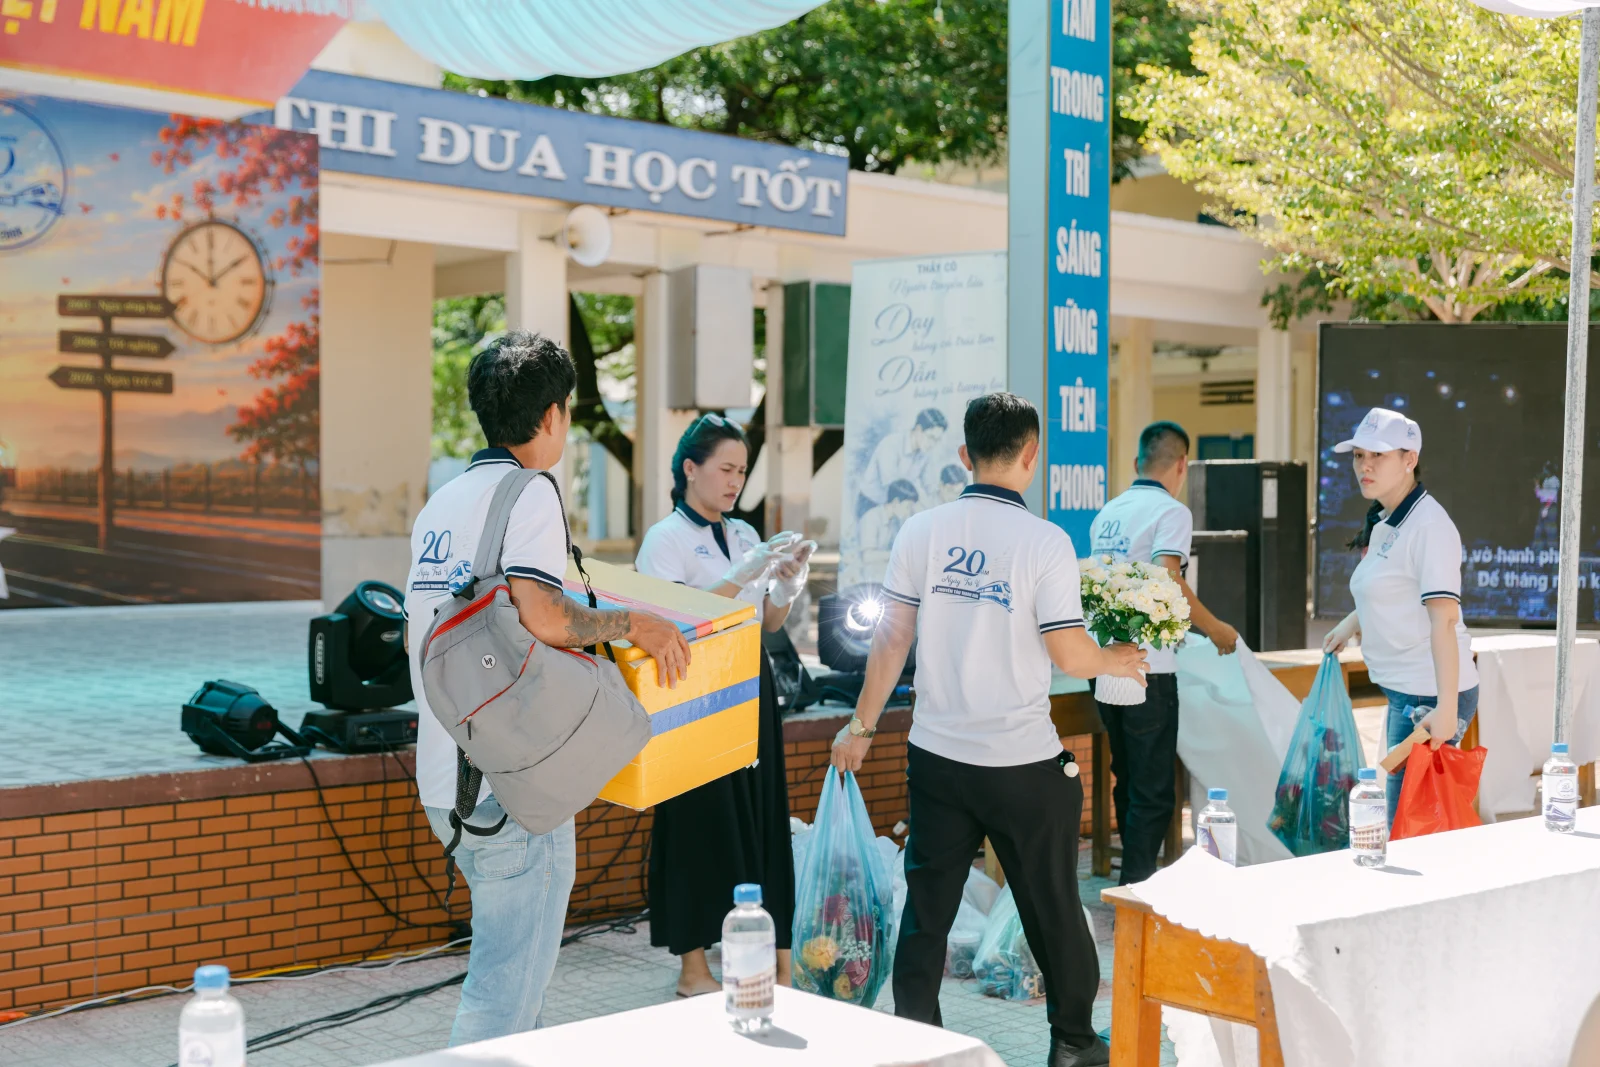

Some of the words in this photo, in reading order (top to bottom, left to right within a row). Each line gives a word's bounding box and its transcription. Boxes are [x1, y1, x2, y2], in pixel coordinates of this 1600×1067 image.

[1051, 65, 1103, 122] TRONG
[417, 117, 567, 181] ĐUA
[584, 142, 717, 204] HỌC
[731, 157, 841, 217] TỐT
[1064, 143, 1090, 198] TRÍ
[1056, 219, 1101, 278] SÁNG
[871, 302, 935, 346] Dạy
[1053, 298, 1098, 355] VỮNG
[875, 355, 937, 397] Dẫn
[1059, 376, 1096, 432] TIÊN
[1050, 463, 1105, 511] PHONG
[418, 529, 452, 565] 20
[1098, 519, 1121, 539] 20
[943, 546, 986, 577] 20
[1504, 570, 1549, 592] tháng
